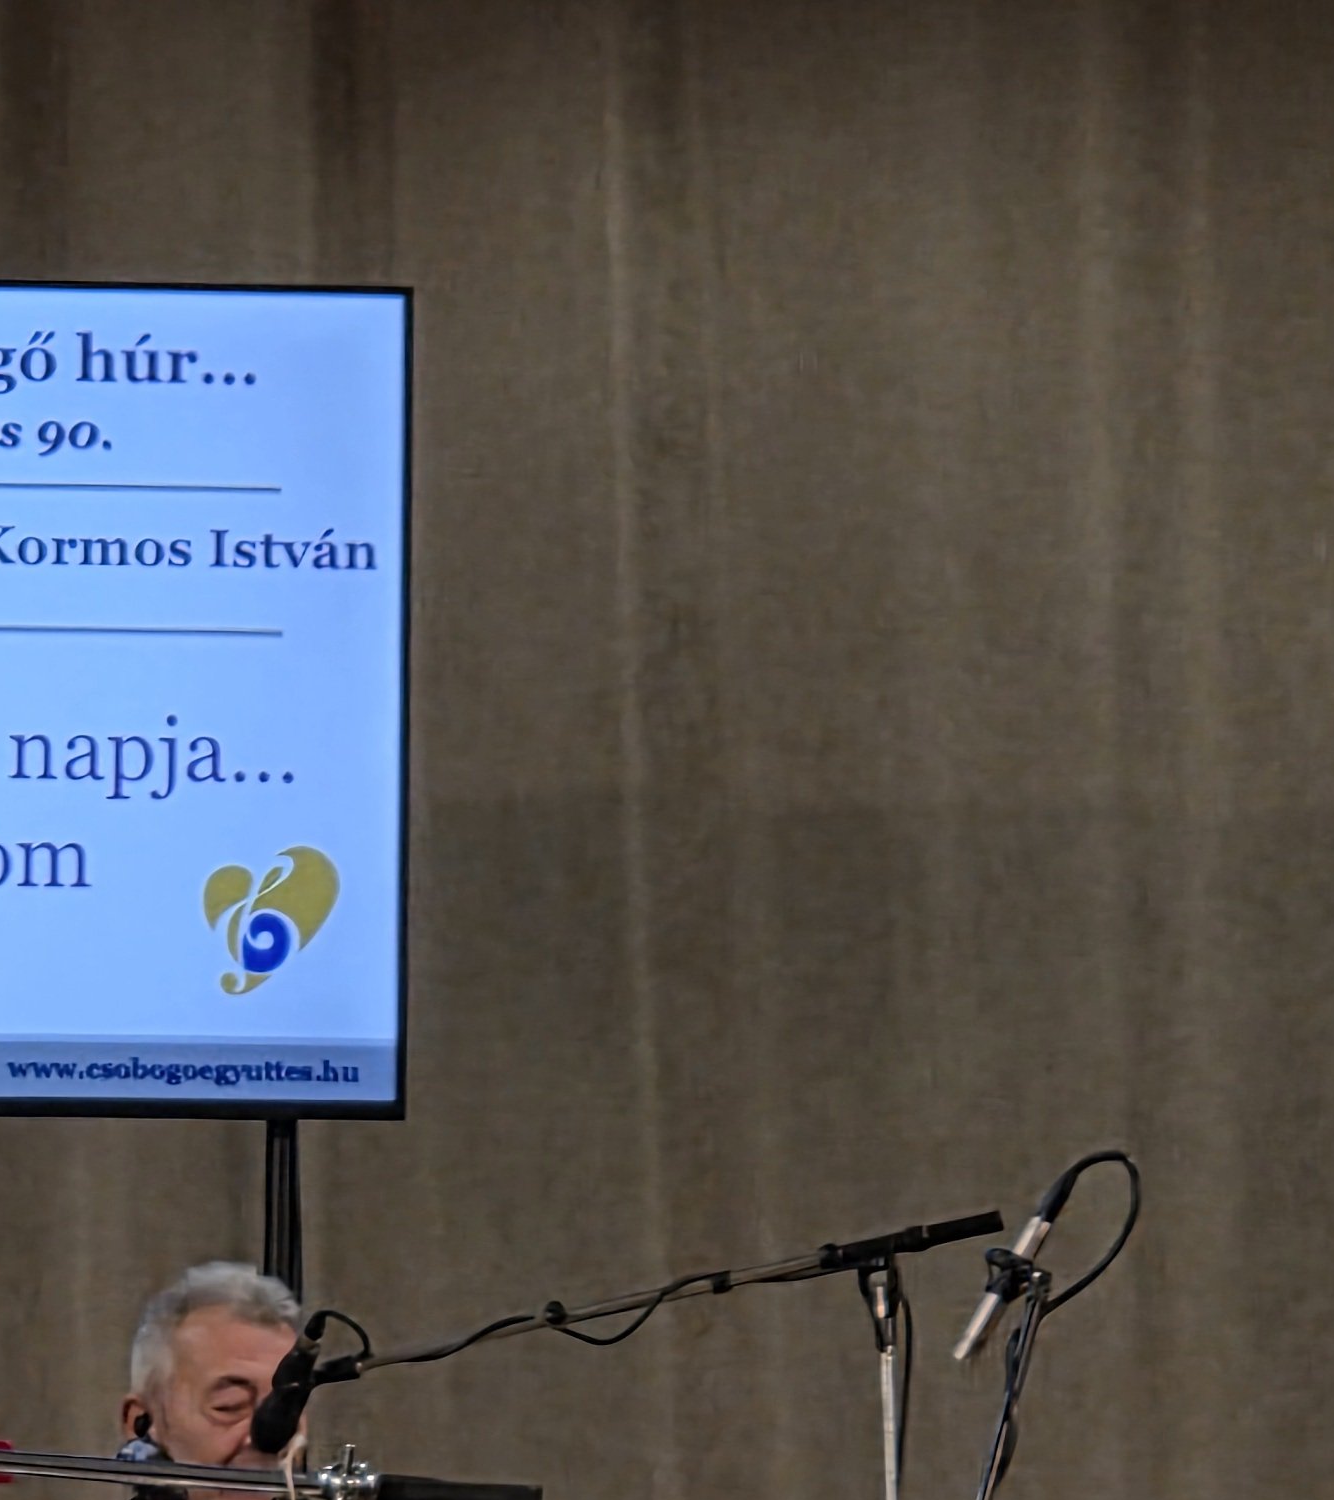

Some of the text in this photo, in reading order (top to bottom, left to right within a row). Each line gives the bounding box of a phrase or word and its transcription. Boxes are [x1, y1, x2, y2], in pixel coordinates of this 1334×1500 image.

[75, 331, 257, 386] húr...
[37, 420, 112, 457] 90.
[209, 527, 377, 571] István
[9, 714, 295, 801] napja...
